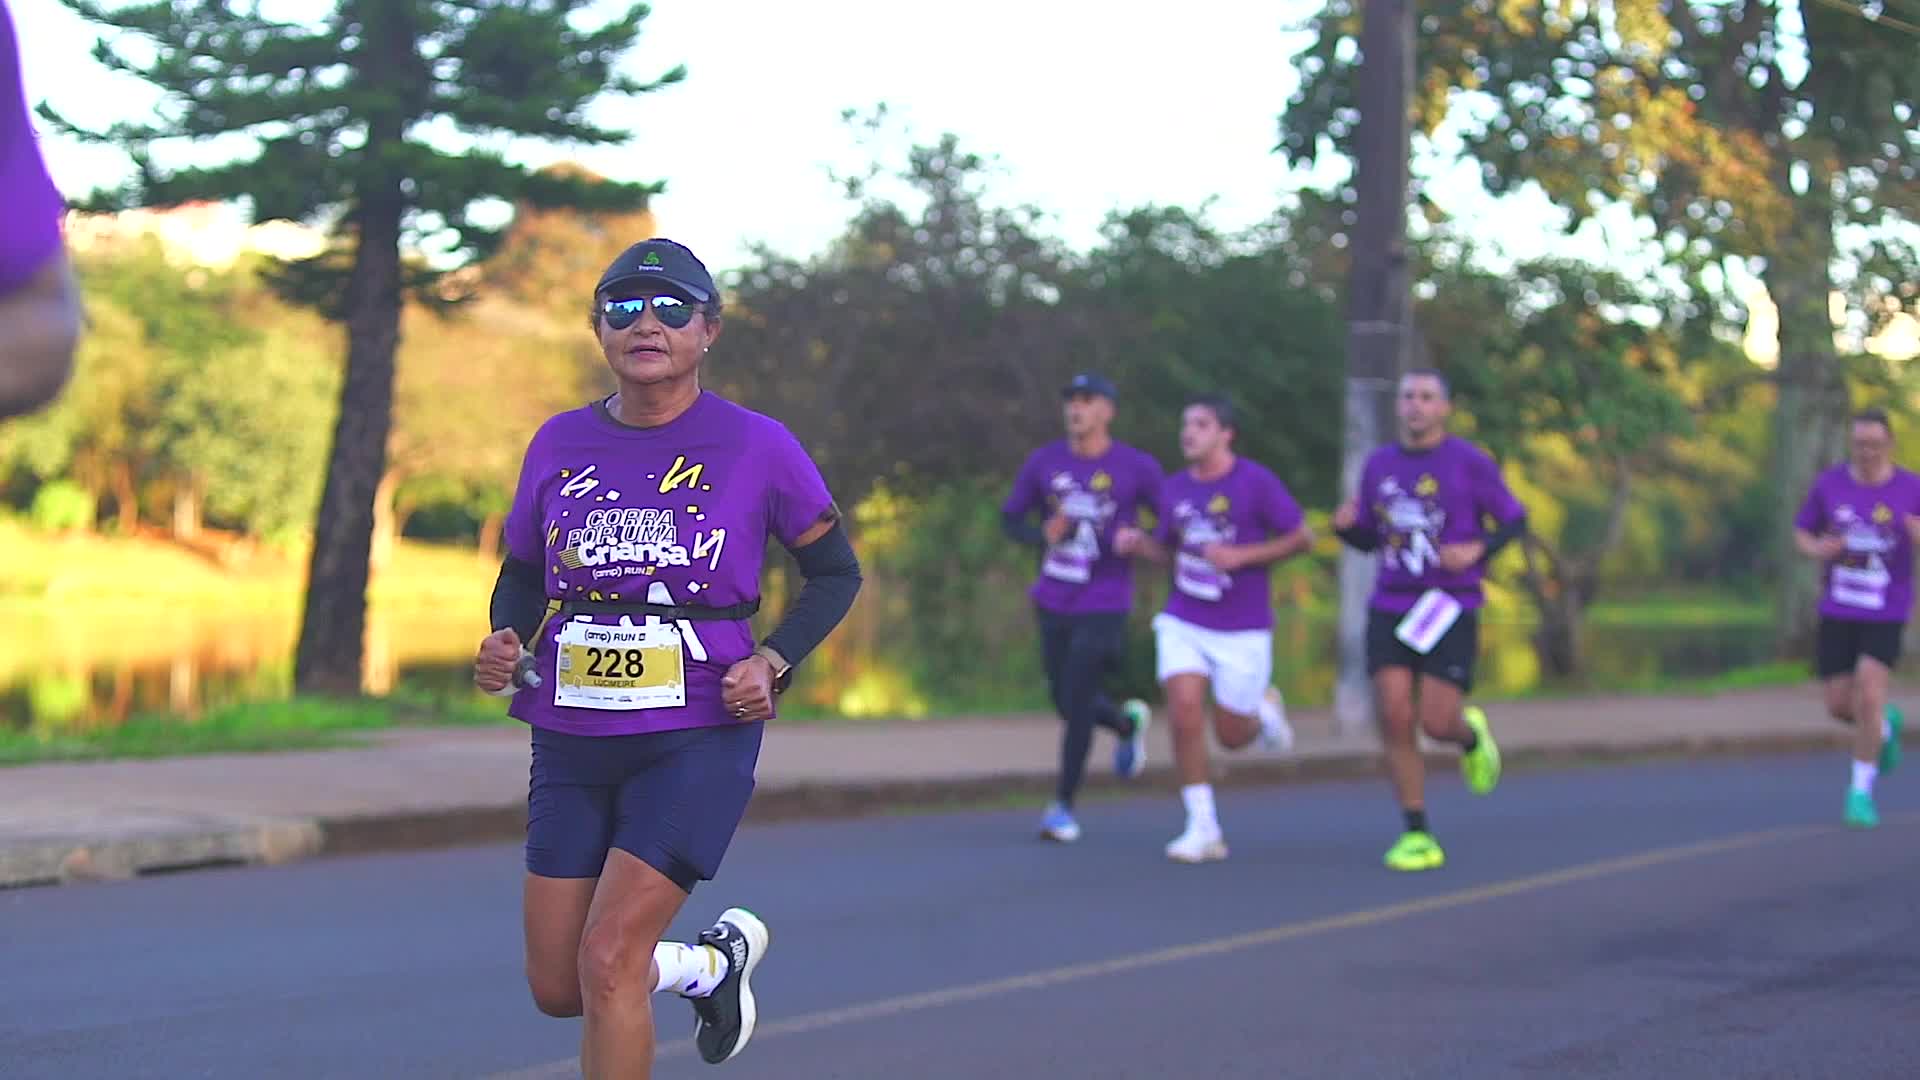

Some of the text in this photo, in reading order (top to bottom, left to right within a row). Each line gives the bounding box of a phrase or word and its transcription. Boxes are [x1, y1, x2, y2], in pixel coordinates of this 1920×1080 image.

[567, 525, 677, 549] POR UMA
[578, 540, 691, 567] Criança
[624, 566, 646, 576] RUN
[613, 632, 636, 642] RUN
[586, 647, 644, 678] 228
